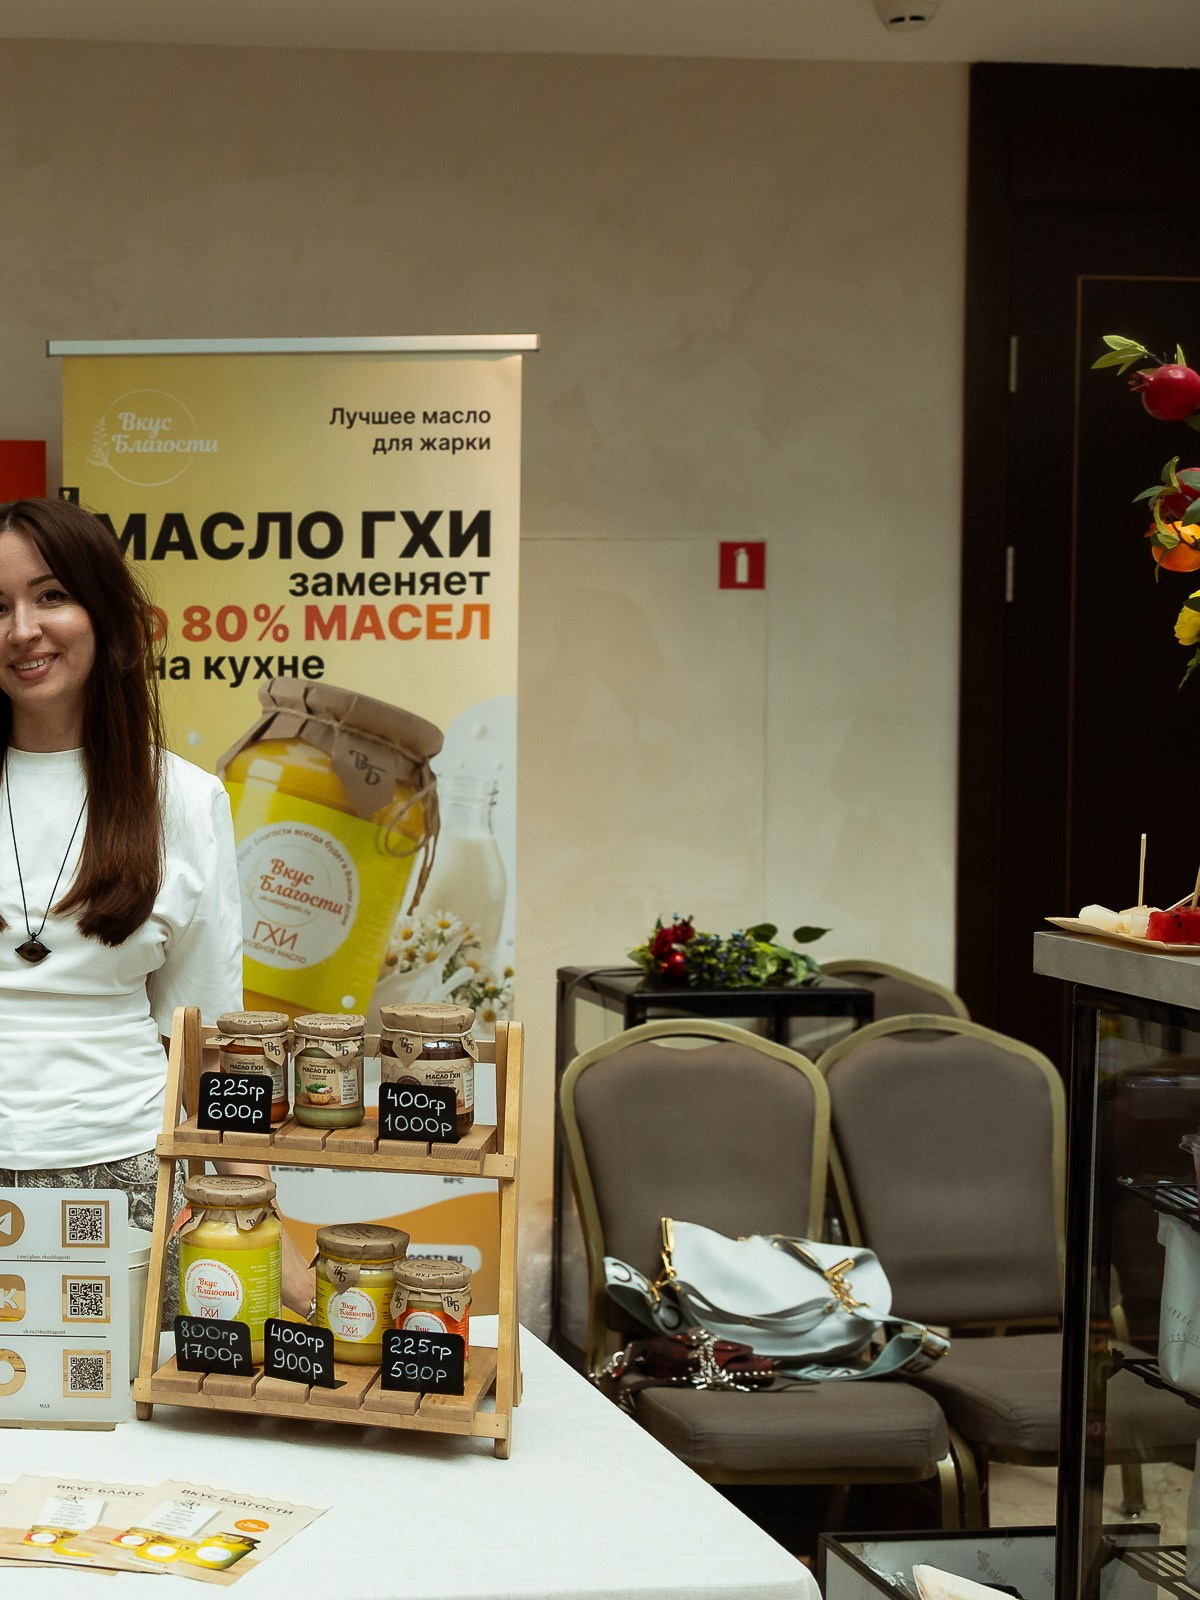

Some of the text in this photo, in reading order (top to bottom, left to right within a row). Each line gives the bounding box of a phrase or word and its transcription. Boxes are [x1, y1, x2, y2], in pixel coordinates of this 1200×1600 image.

[117, 411, 173, 439] Вкус
[329, 406, 492, 429] Лучшее масло
[110, 433, 219, 455] Благости
[371, 437, 492, 455] для жарки
[95, 510, 492, 561] МАСЛО ГХИ
[288, 570, 491, 598] заменяет
[181, 604, 290, 644] 80%
[305, 603, 491, 642] МАСЕЛ
[203, 655, 325, 689] кухне
[270, 857, 315, 888] Вкус
[259, 874, 344, 916] Благости
[252, 920, 299, 951] ГХИ
[278, 948, 307, 965] МАСЛО
[302, 1066, 322, 1074] МАСЛО
[209, 1078, 265, 1101] 225гр
[208, 1102, 263, 1124] 600р
[387, 1088, 446, 1116] 400гр
[384, 1113, 452, 1137] 1000р
[196, 1285, 236, 1297] Благости
[198, 1277, 218, 1289] Вкус
[200, 1306, 219, 1318] ГХИ
[339, 1308, 372, 1318] Благости
[341, 1301, 358, 1311] Вкус
[443, 1295, 460, 1312] ВБ
[181, 1320, 239, 1346] 800гр
[270, 1324, 325, 1353] 400гр
[341, 1325, 359, 1334] ГХИ
[181, 1343, 243, 1369] 1700р
[390, 1336, 452, 1361] 225гр
[273, 1349, 324, 1380] 900р
[390, 1361, 447, 1383] 590р
[56, 1484, 145, 1497] ВКУС БЛАГО
[181, 1489, 295, 1516] ВКУС БЛАГОСТИ
